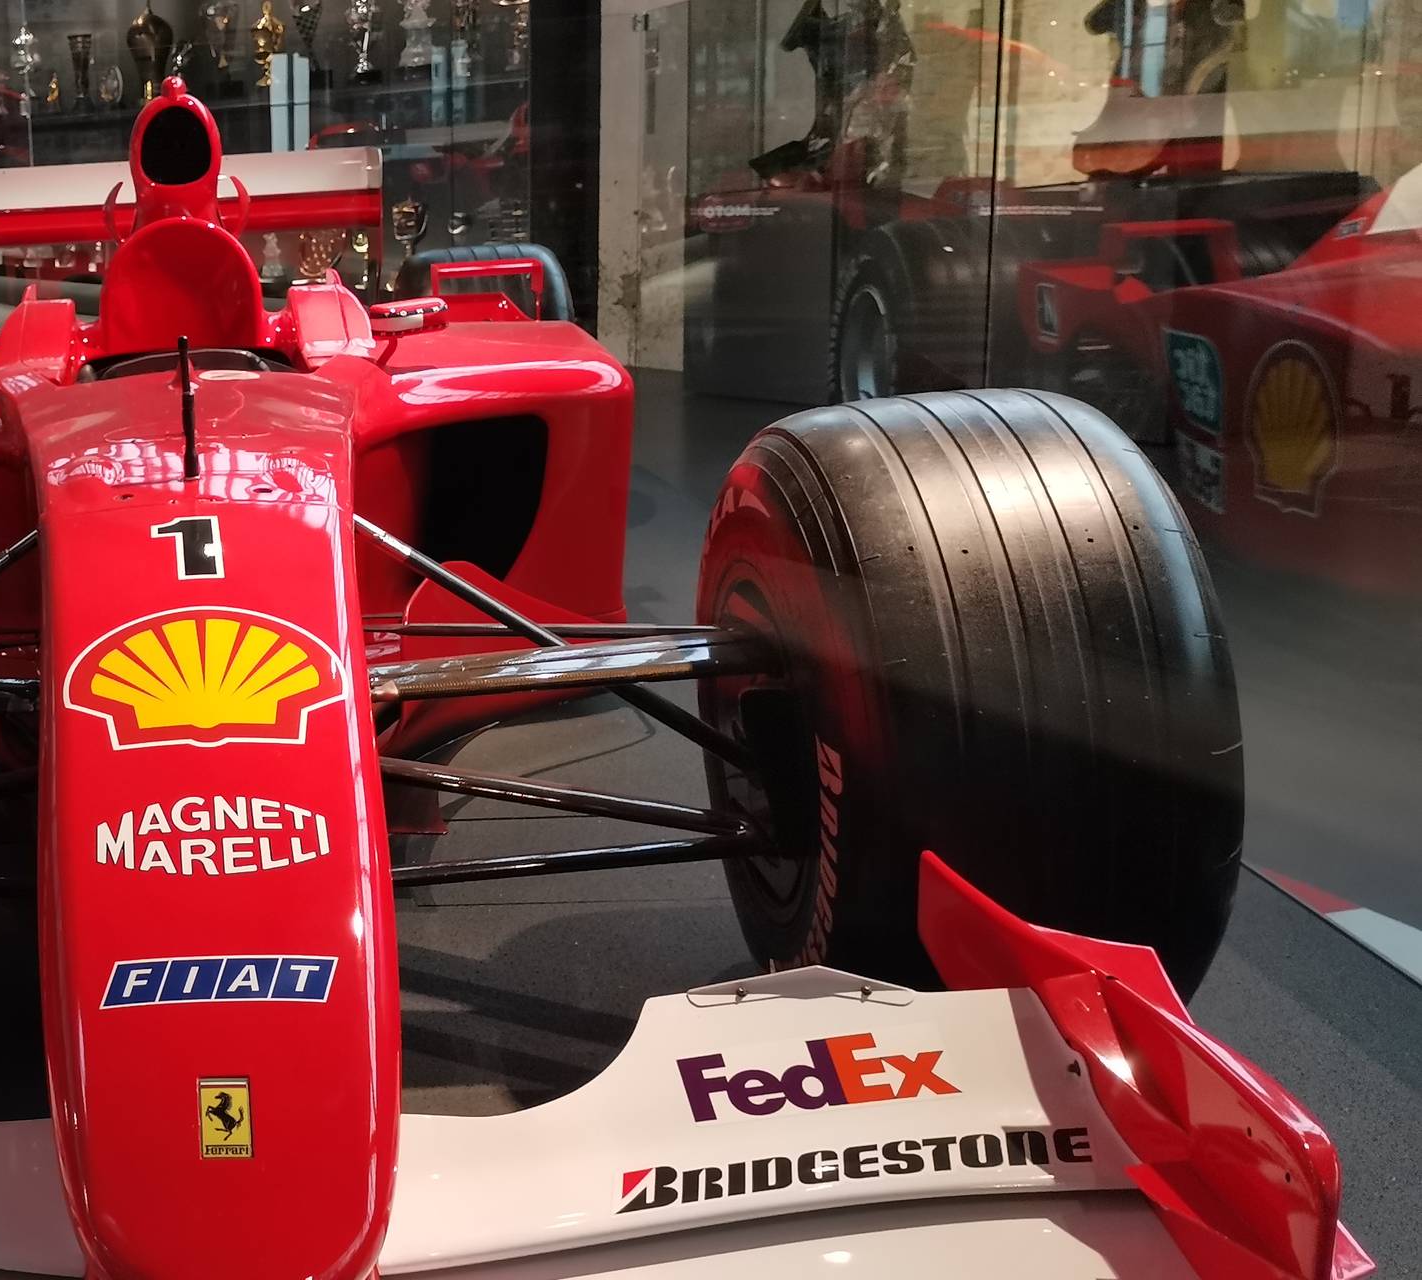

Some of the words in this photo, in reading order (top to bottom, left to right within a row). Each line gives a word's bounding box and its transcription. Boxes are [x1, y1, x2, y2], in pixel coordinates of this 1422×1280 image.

[149, 514, 226, 581] 1
[96, 796, 331, 853] MAGNETI
[96, 825, 331, 875] MARELLI
[121, 963, 321, 998] FIAT
[675, 1032, 963, 1123] FedEx
[204, 1144, 250, 1156] Ferrari
[614, 1126, 1094, 1215] BRIDGESTONE
